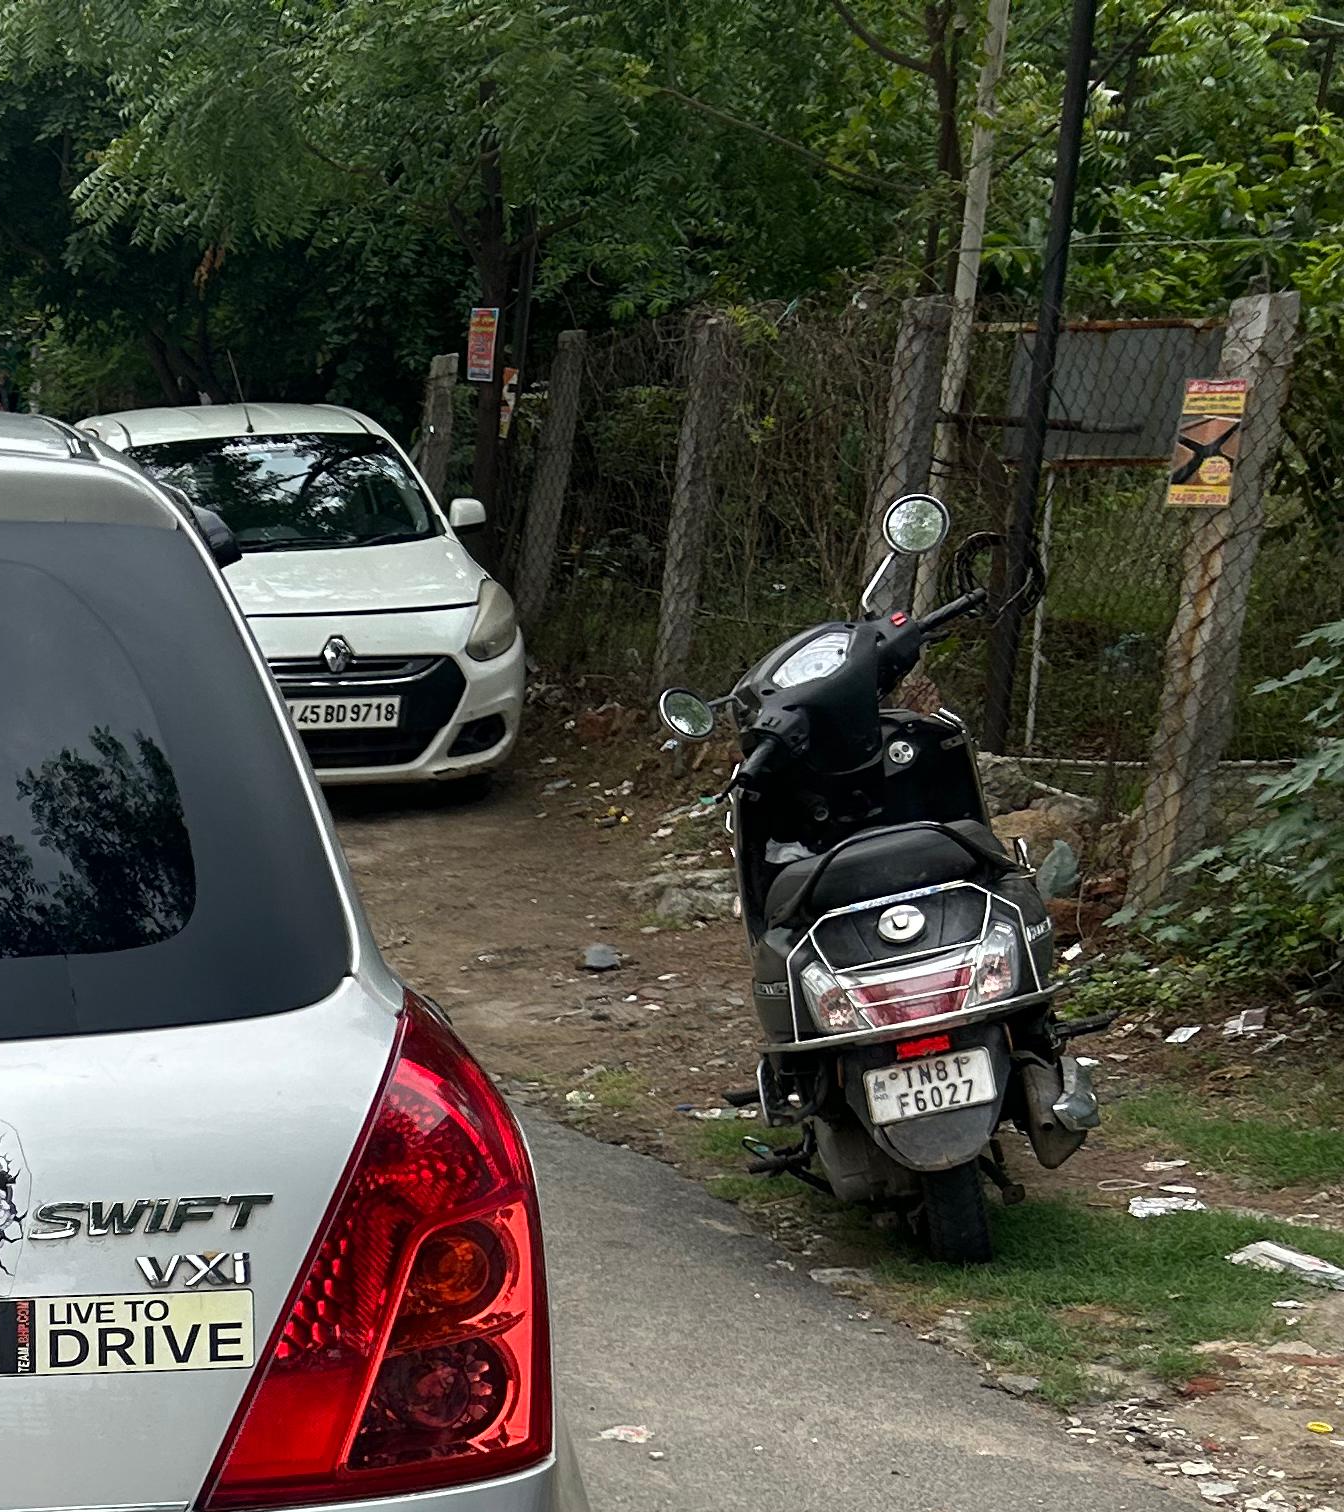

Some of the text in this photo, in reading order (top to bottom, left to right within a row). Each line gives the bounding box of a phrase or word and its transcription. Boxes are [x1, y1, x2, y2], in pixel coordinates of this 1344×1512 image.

[902, 1056, 963, 1089] TN81
[897, 1079, 974, 1117] F6027
[28, 1193, 274, 1241] SWIFT
[49, 1299, 170, 1325] LIVE TO
[49, 1322, 244, 1369] DRIVE
